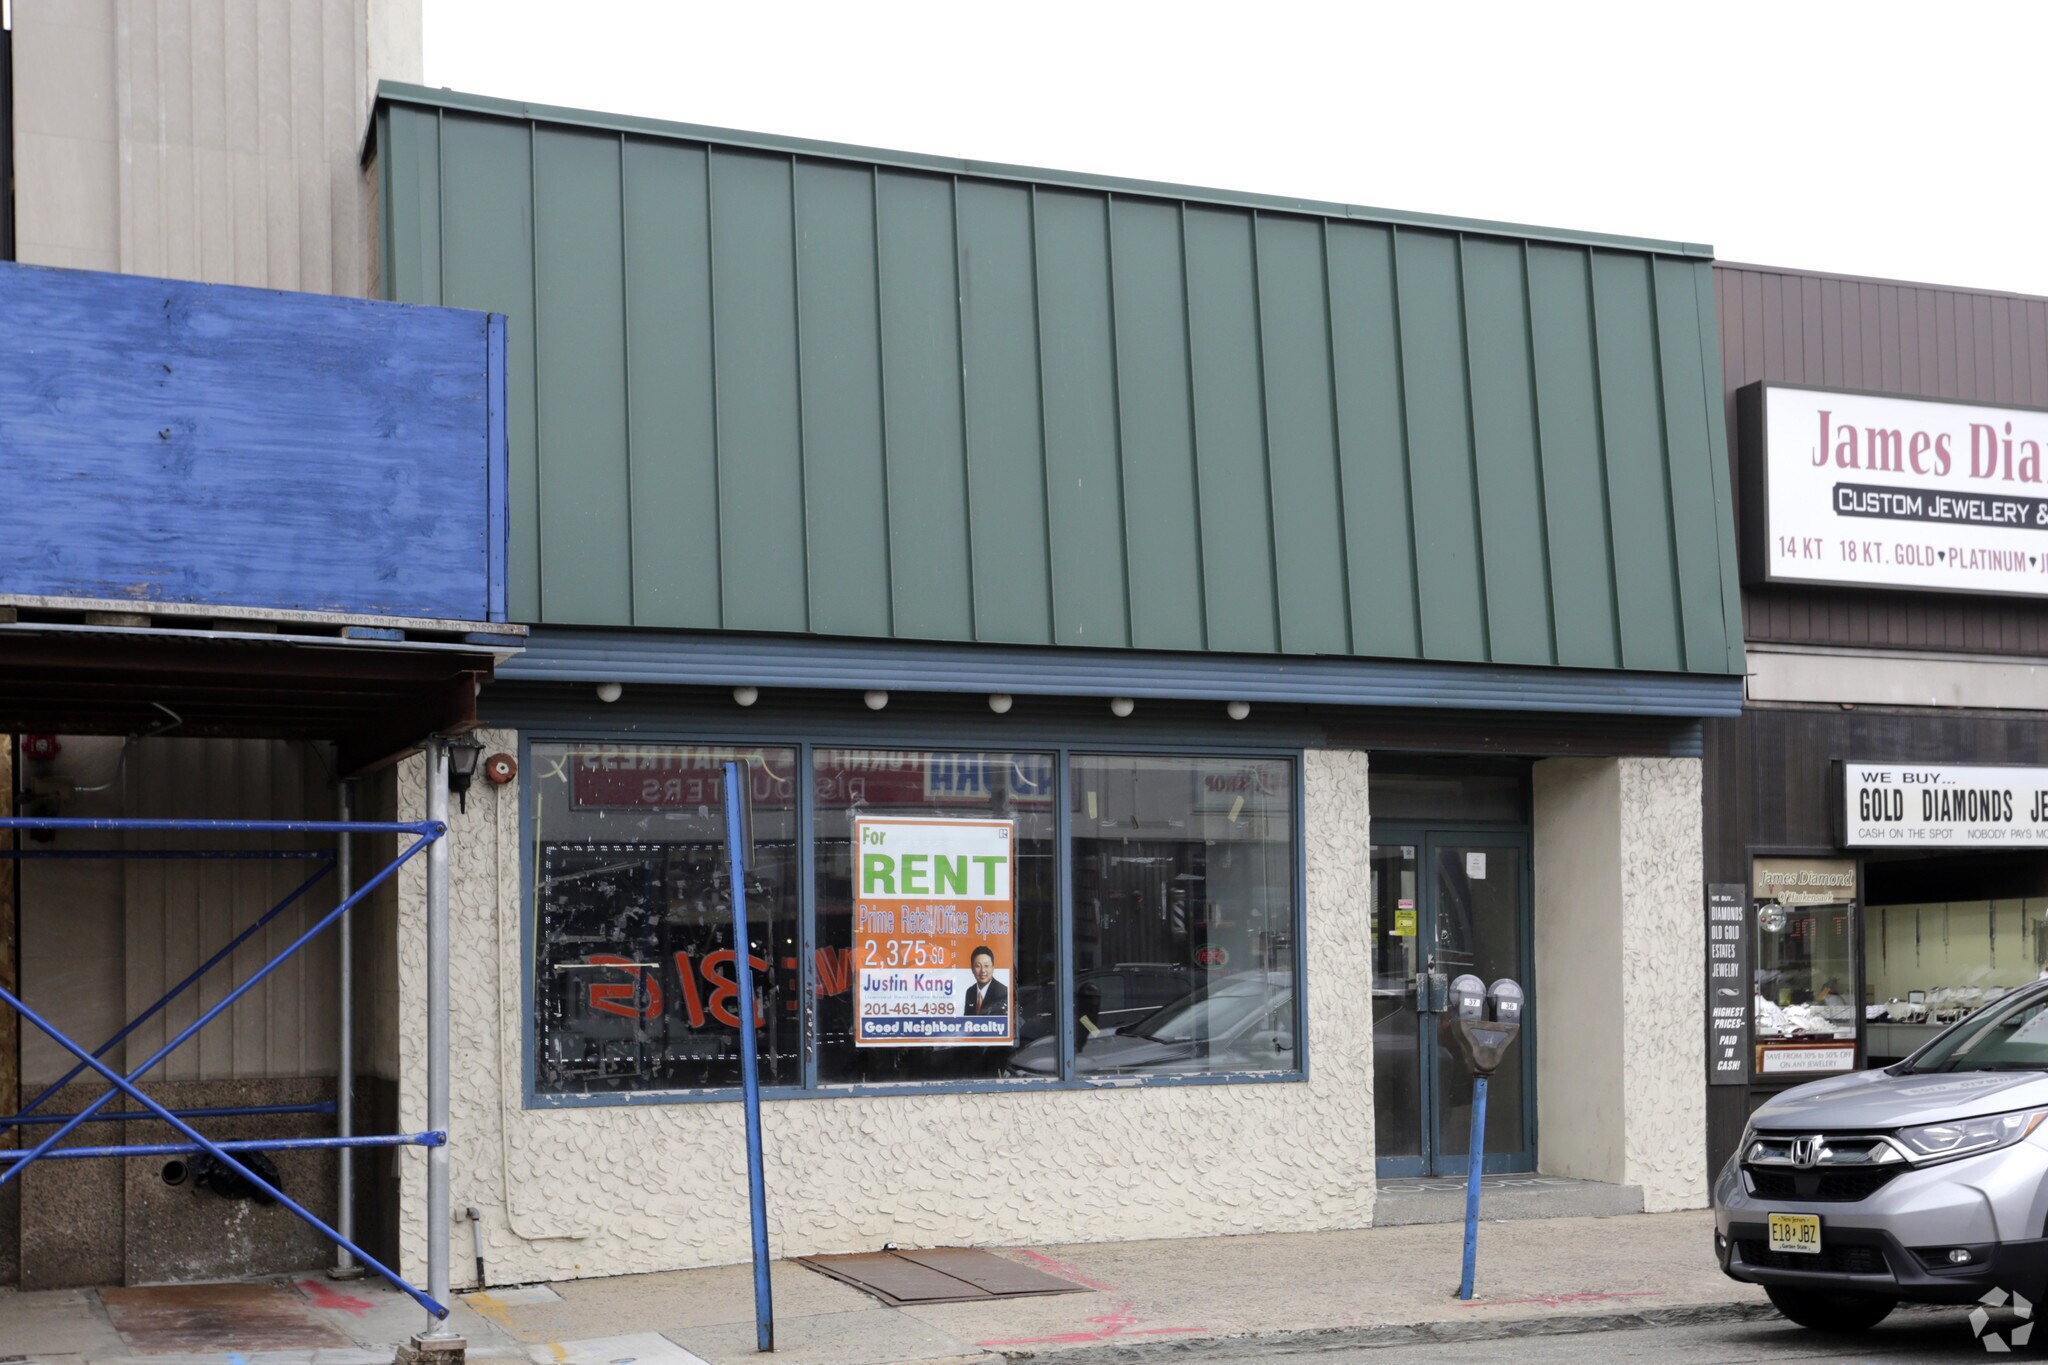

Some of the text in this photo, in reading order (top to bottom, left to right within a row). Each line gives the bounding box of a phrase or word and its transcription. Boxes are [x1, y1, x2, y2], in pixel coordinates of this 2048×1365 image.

[1812, 409, 2048, 484] James Dia
[1838, 488, 1922, 516] CUSTOM
[1928, 495, 2030, 524] JEWELERY
[1778, 536, 1797, 558] 14
[1803, 537, 1823, 560] KT
[1839, 540, 1857, 562] 18
[1863, 541, 1889, 564] KT.
[1895, 543, 1935, 567] GOLD
[1949, 547, 2026, 572] PLATINUM
[1861, 772, 1956, 785] WE BUY...
[1860, 788, 1904, 822] GOLD
[1922, 788, 2013, 823] DIAMONDS
[862, 827, 886, 846] For
[1858, 828, 1885, 839] CASH
[1889, 828, 1904, 839] ON
[1908, 828, 1926, 839] THE
[1929, 828, 1954, 839] SPOT
[1967, 829, 2007, 840] NOBODY
[2011, 829, 2032, 839] PAYS
[863, 853, 1008, 896] RENT
[1758, 869, 1854, 888] James Diamond
[1711, 906, 1743, 921] DIAMONDS
[859, 904, 1010, 941] Prime Retail/Office Space
[1711, 925, 1740, 940] OLD GOLD
[864, 939, 927, 969] 2,375
[1711, 943, 1736, 959] ESTATES
[1711, 963, 1739, 978] JEWELRY
[863, 973, 953, 996] Justin Kang
[864, 1002, 955, 1016] 201-461-4989
[1712, 1006, 1745, 1017] HIGHEST
[864, 1020, 1005, 1035] Good Neighbor Realty
[1719, 1035, 1738, 1045] PAID
[1724, 1047, 1734, 1058] IN
[1766, 1052, 1781, 1060] SAVE
[1782, 1051, 1802, 1060] FROM
[1839, 1050, 1852, 1059] OFF
[1717, 1060, 1741, 1071] CASH!
[1780, 1061, 1791, 1069] ON
[1791, 1060, 1807, 1068] ANY
[1772, 1223, 1816, 1243] E18 JBZ
